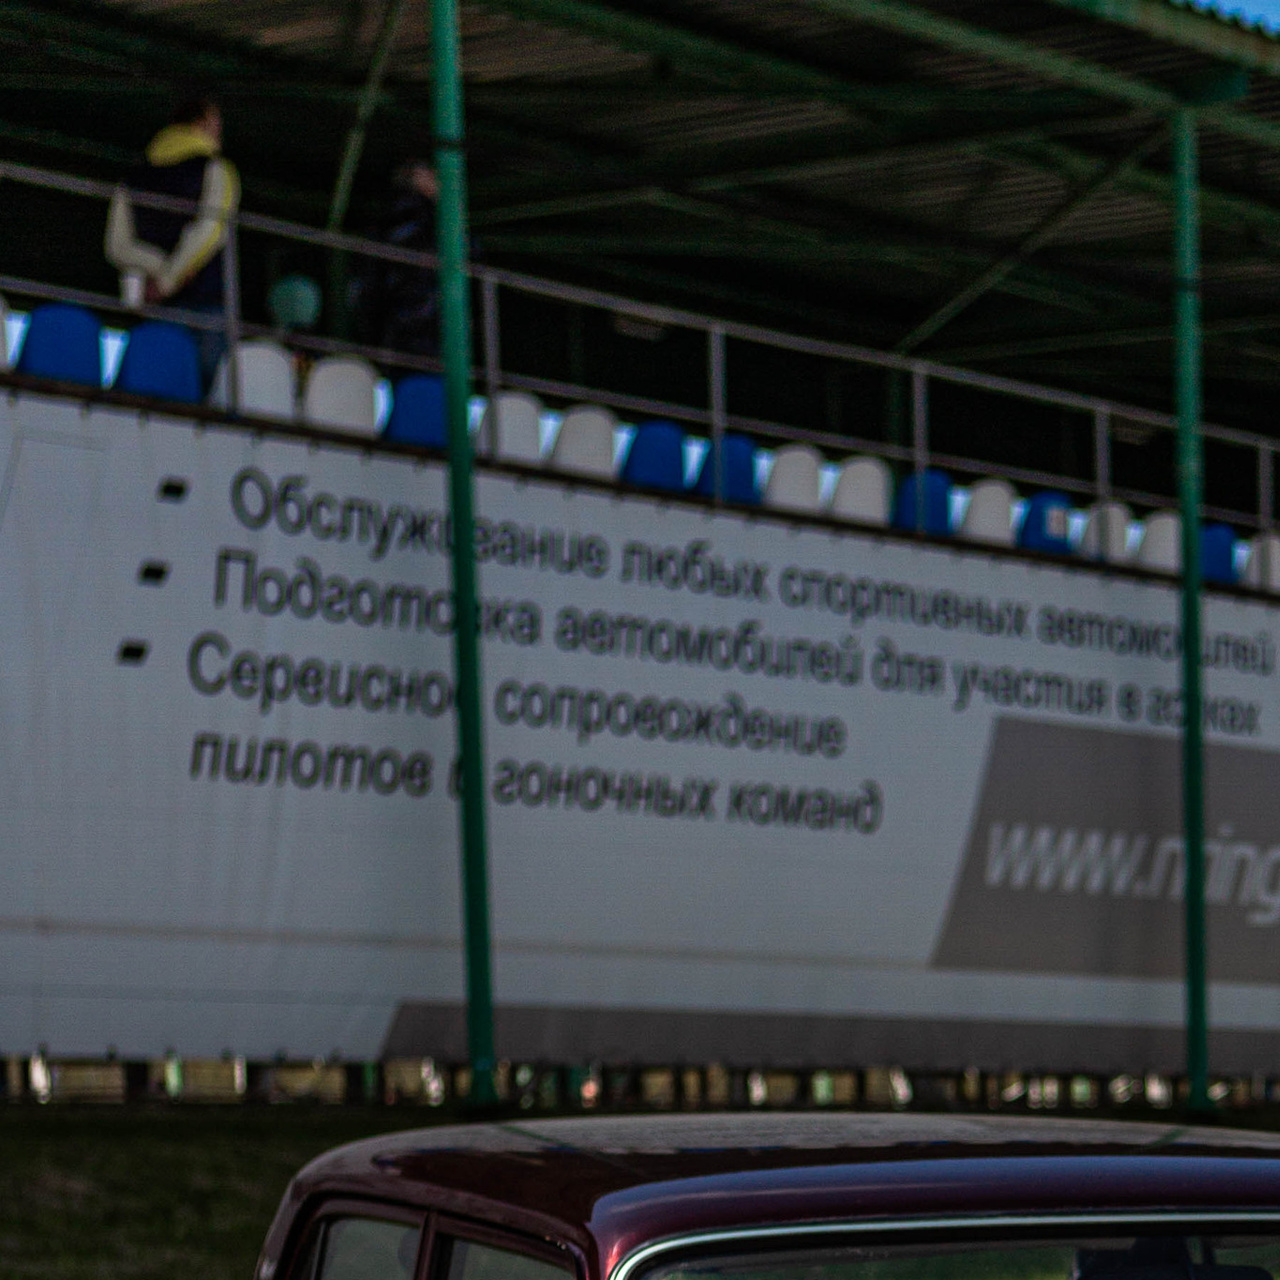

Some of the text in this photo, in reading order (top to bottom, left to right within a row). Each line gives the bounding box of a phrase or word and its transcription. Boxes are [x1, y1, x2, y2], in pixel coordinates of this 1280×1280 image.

[215, 546, 1262, 735] Подготока автомобилей для участия в гоках
[621, 539, 769, 601] любых
[780, 565, 1031, 637] спортивных
[1037, 604, 1276, 677] автомоилей
[187, 630, 849, 759] Сервисно сопровождение
[190, 732, 434, 798] пилотов
[493, 758, 719, 821] гоночных
[727, 778, 884, 835] команд
